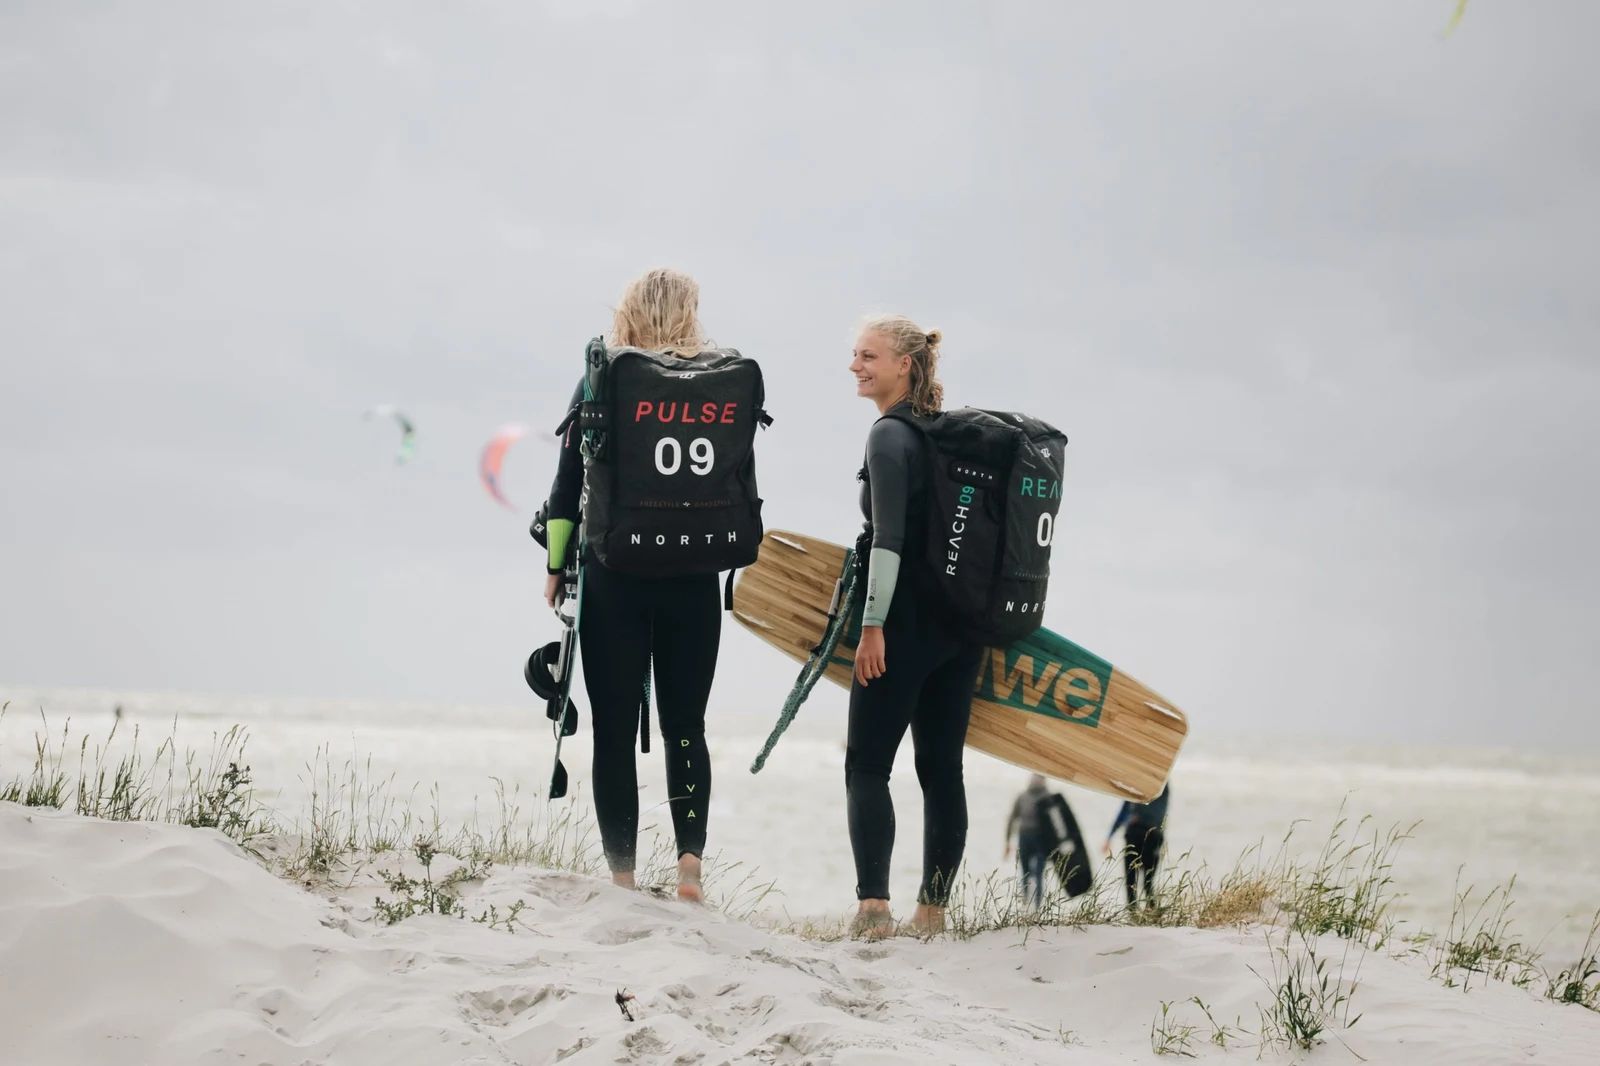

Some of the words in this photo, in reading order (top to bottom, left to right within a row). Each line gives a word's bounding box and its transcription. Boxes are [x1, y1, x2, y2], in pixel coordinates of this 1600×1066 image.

[635, 401, 737, 424] PULSE
[654, 437, 715, 476] 09
[957, 467, 993, 480] NORTH
[1021, 477, 1063, 499] REA
[631, 531, 737, 546] NORTH
[1037, 512, 1054, 547] 0
[974, 646, 1102, 719] we
[681, 739, 697, 818] DIVA
